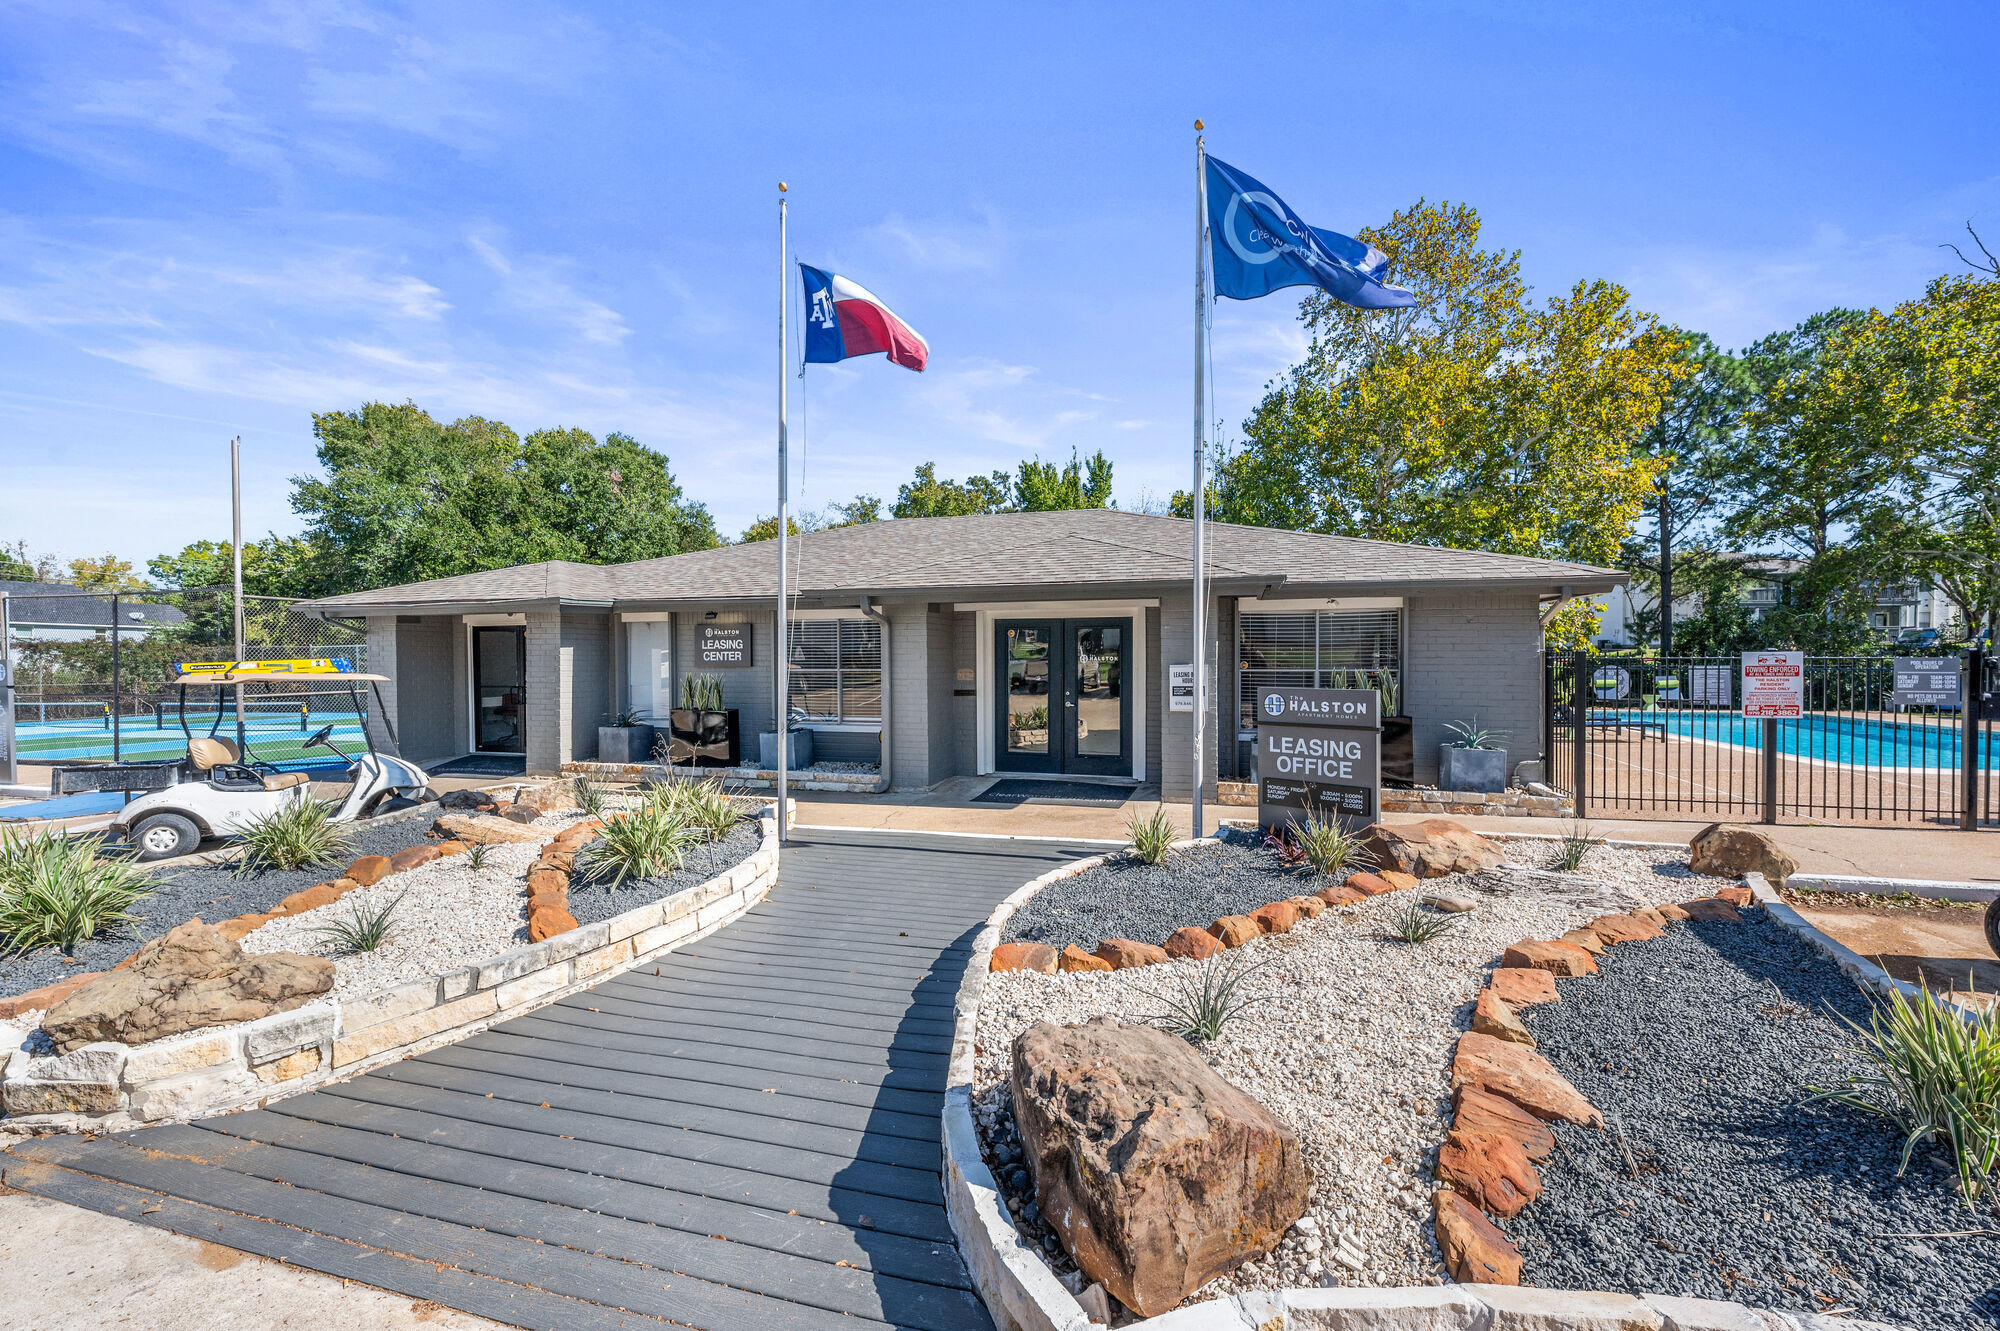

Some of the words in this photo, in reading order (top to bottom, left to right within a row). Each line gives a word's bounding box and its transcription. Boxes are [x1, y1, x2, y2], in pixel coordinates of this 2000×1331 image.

[702, 640, 743, 649] LEASING
[703, 651, 742, 661] CENTER
[1289, 700, 1367, 714] HALSTON
[1269, 736, 1361, 760] LEASING
[1276, 756, 1353, 779] OFFICE
